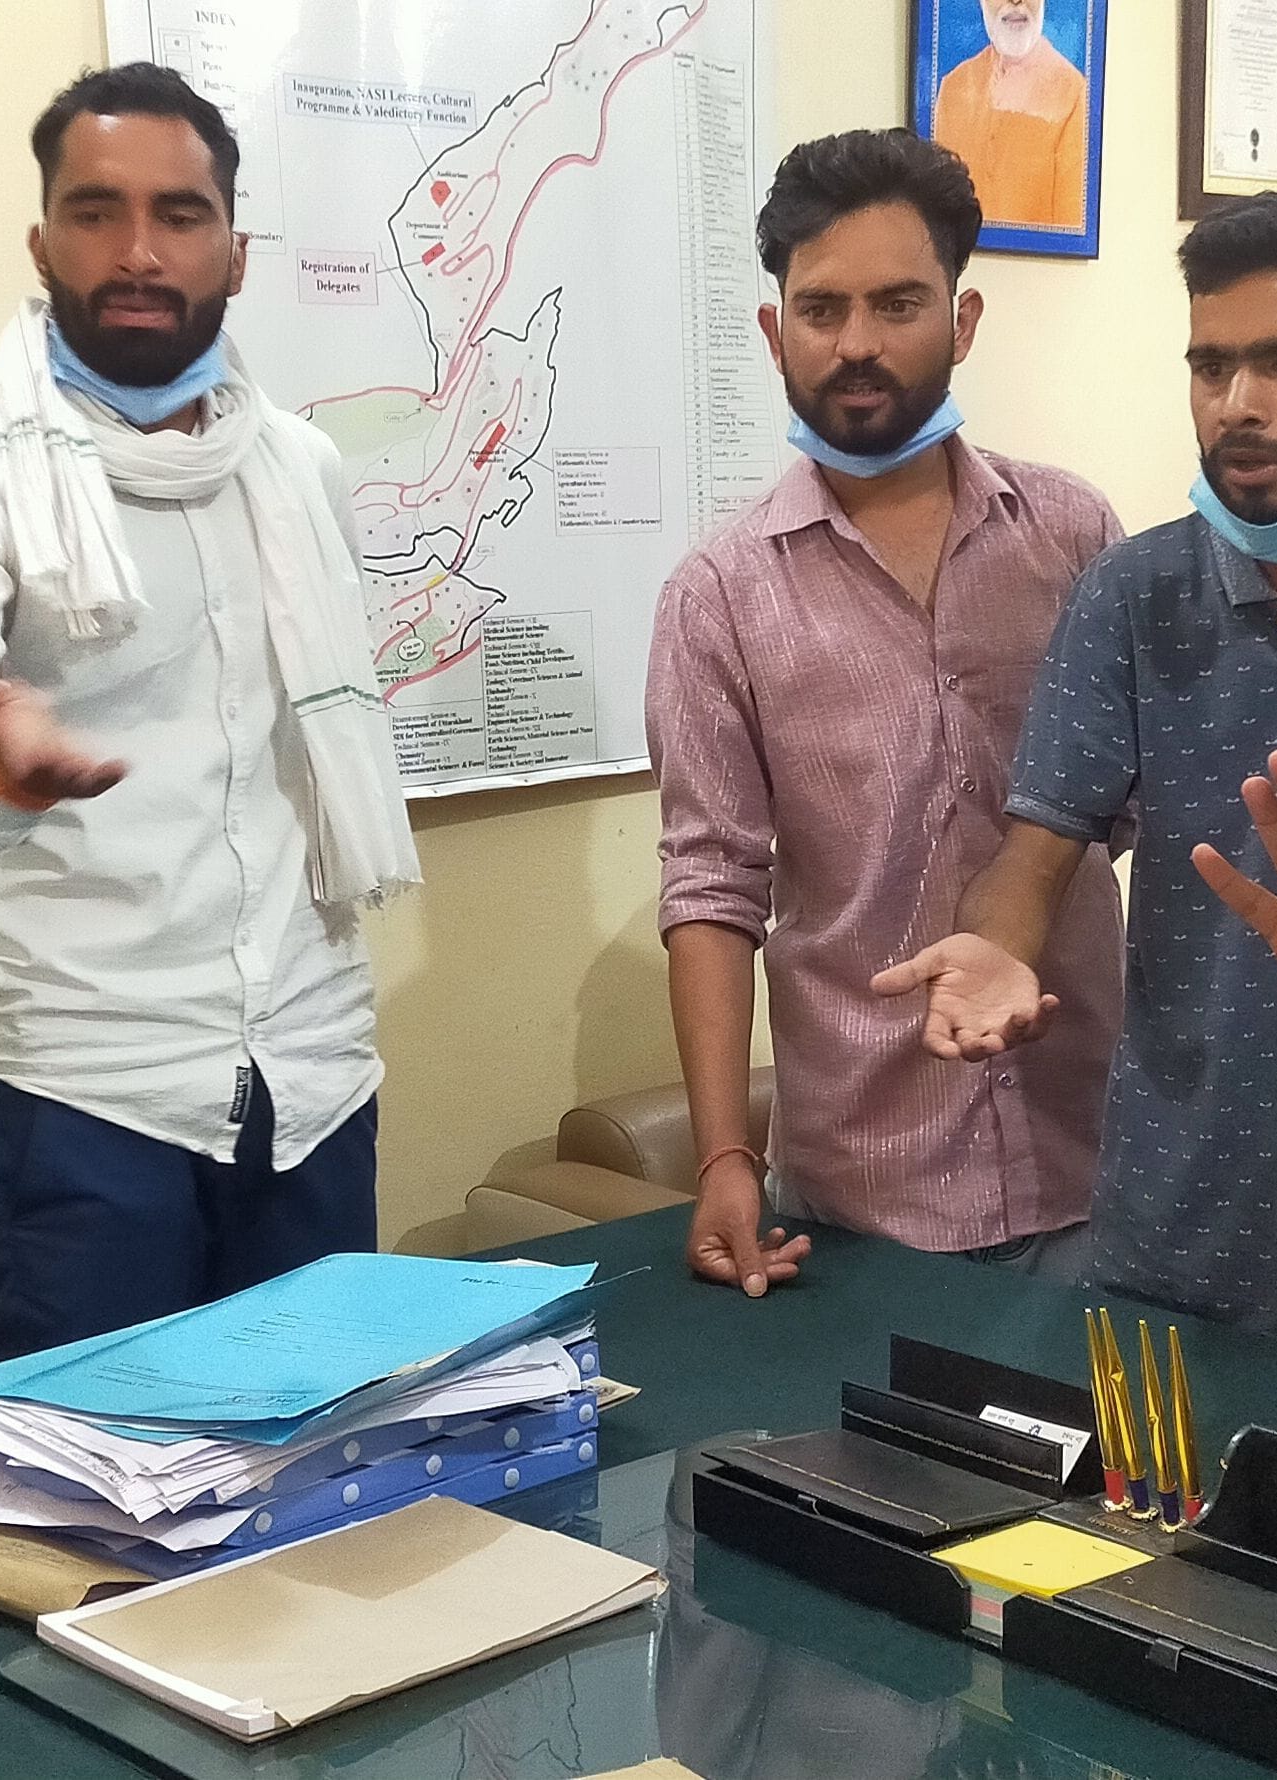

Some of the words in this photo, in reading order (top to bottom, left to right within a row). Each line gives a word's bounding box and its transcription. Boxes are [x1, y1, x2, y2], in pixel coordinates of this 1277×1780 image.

[196, 10, 236, 27] INDEX
[292, 79, 355, 99] Inauguration,
[433, 93, 472, 108] Cultural
[296, 98, 350, 114] Programme
[352, 105, 361, 115] &
[365, 104, 422, 121] Valedictory
[426, 110, 467, 124] Function
[300, 259, 357, 274] Registration
[359, 262, 371, 273] of
[316, 279, 362, 293] Delegates
